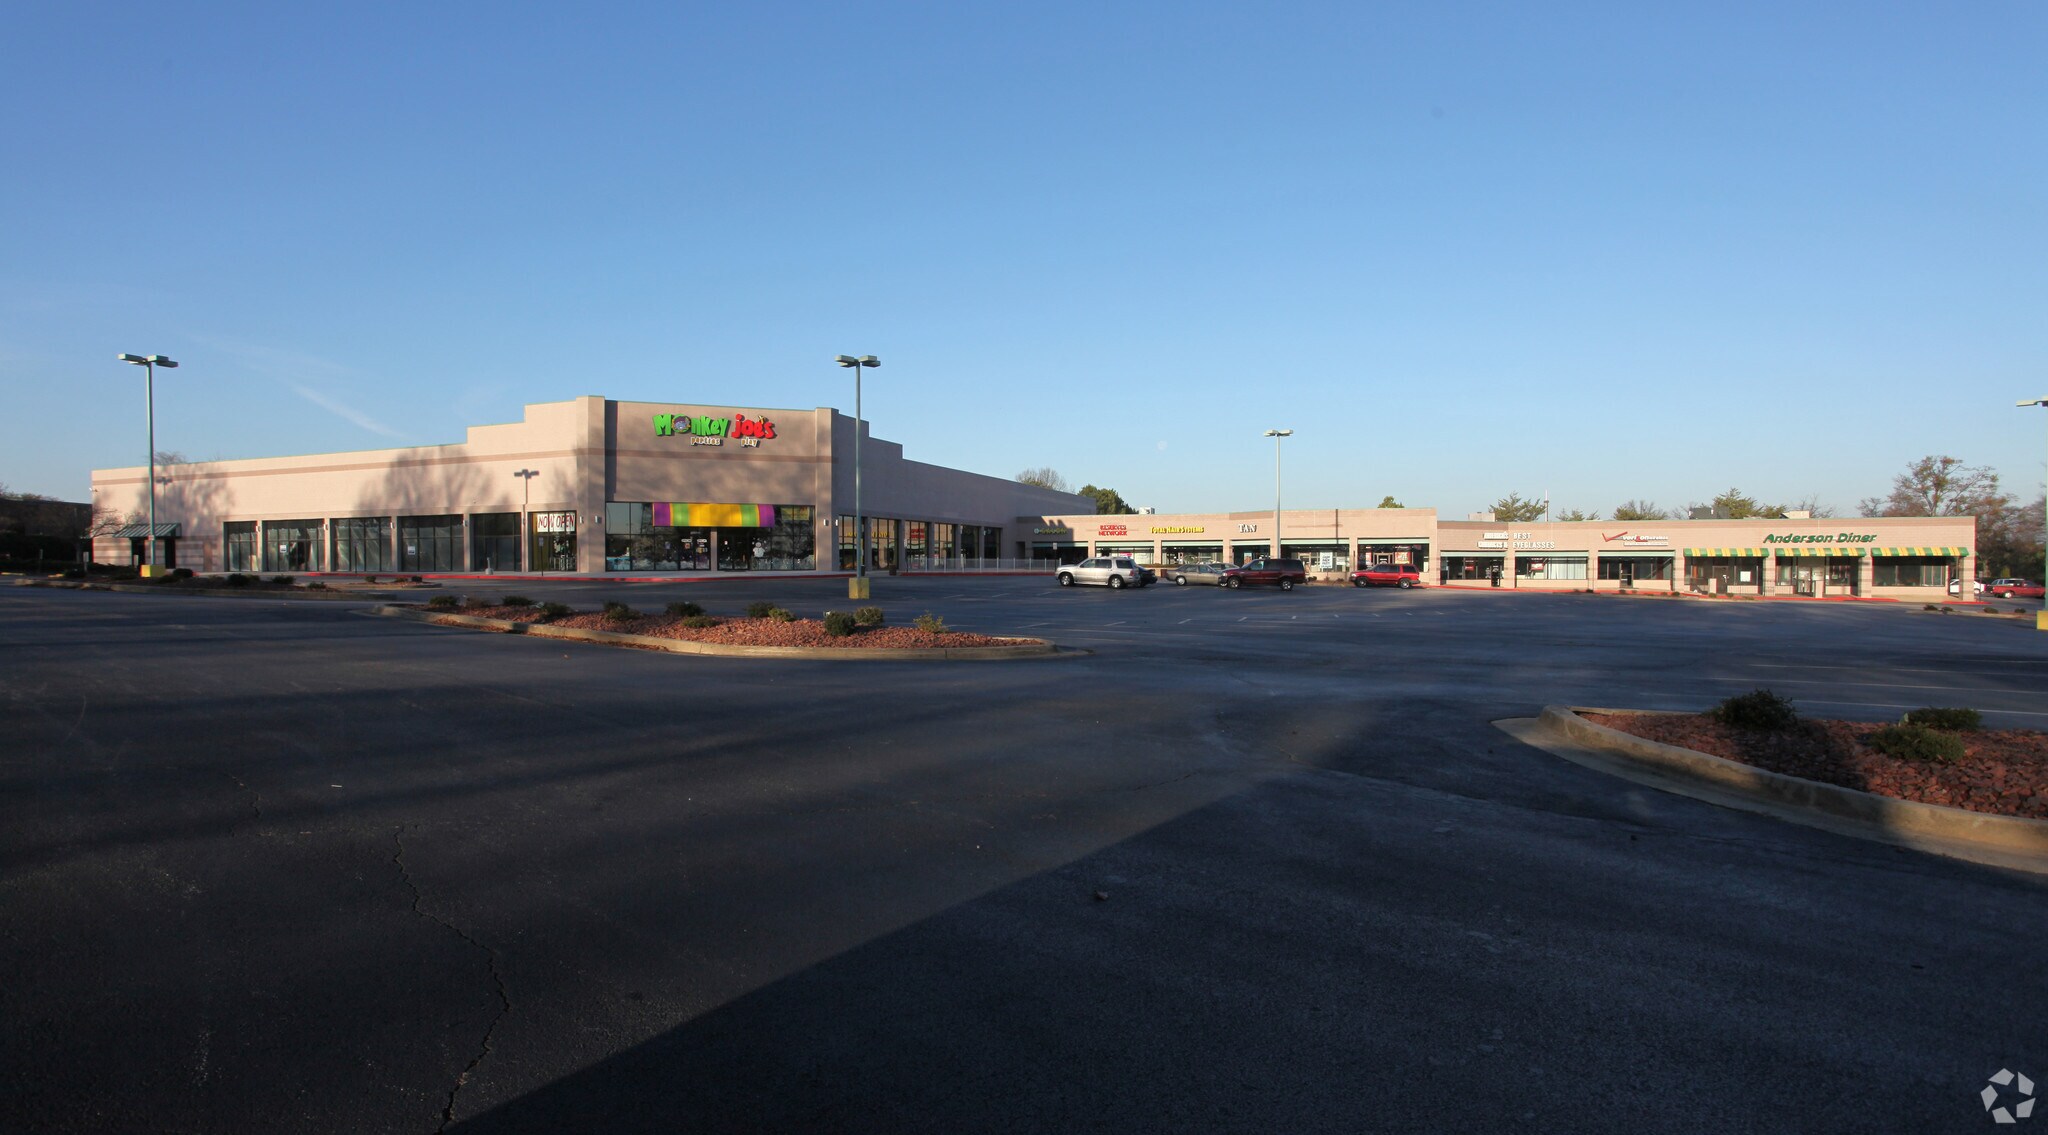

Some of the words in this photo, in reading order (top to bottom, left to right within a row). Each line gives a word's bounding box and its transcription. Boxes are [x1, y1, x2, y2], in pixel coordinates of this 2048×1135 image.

[741, 437, 759, 447] play
[537, 515, 554, 528] NOW
[555, 514, 576, 528] OPEN
[1239, 523, 1258, 533] TAN
[1513, 532, 1532, 541] BEST
[1622, 534, 1649, 542] verizon
[1763, 533, 1834, 543] Anderson
[1836, 532, 1878, 543] Diner
[1513, 541, 1556, 549] EYEGLASSES
